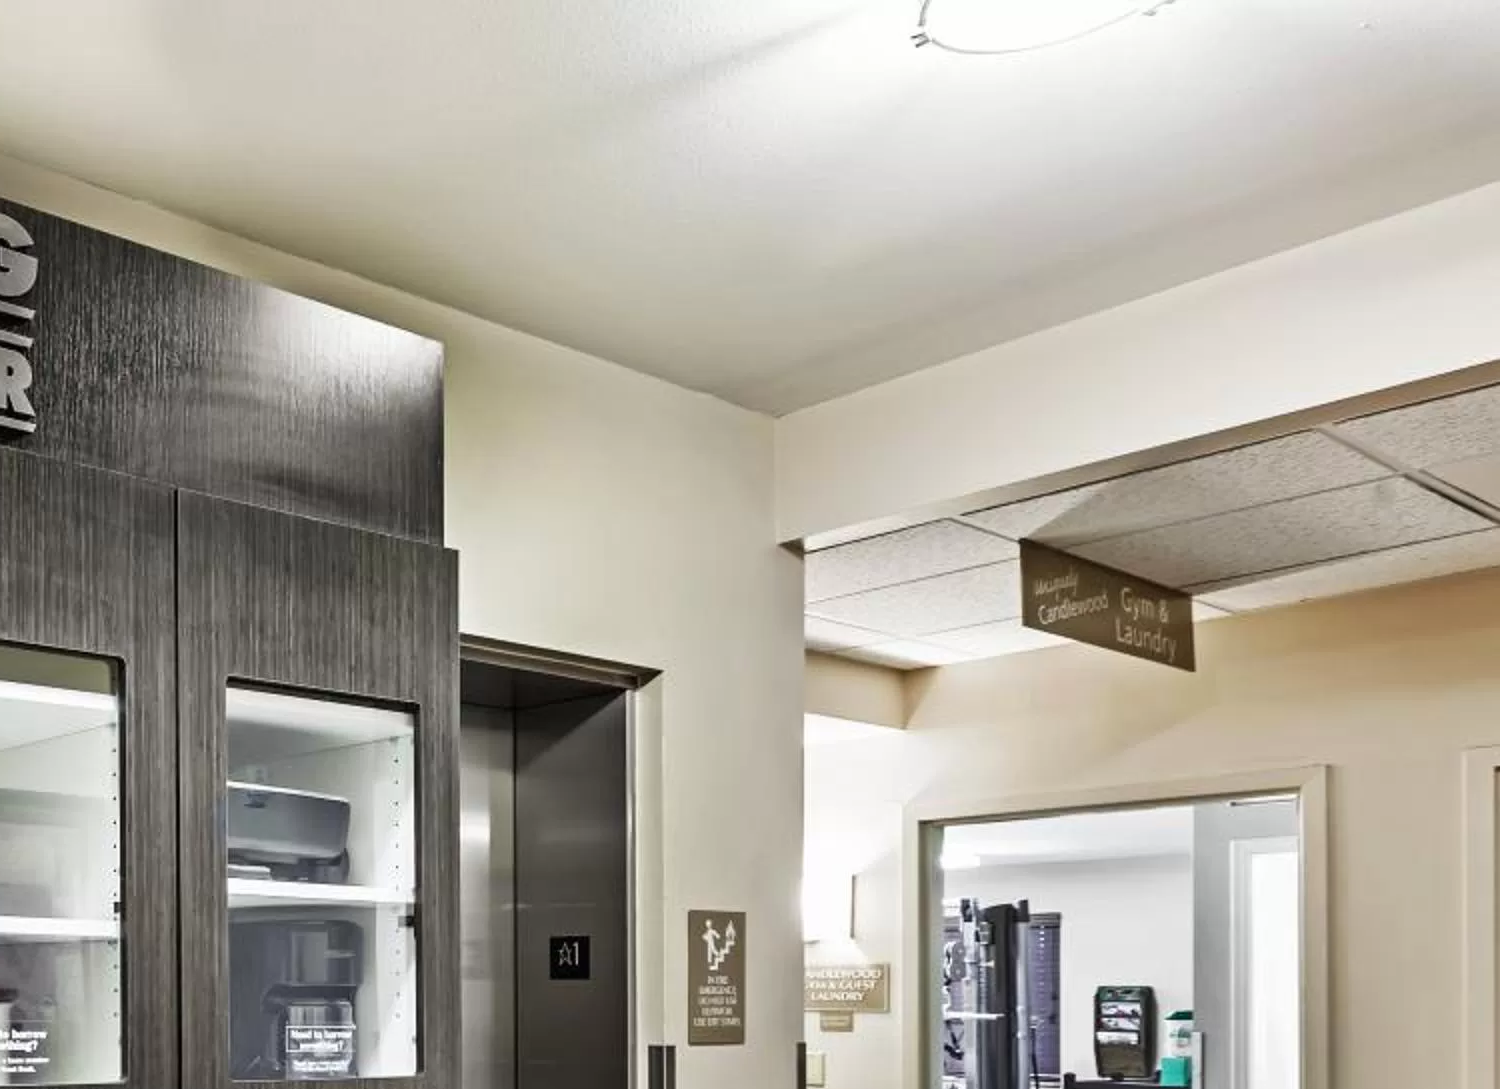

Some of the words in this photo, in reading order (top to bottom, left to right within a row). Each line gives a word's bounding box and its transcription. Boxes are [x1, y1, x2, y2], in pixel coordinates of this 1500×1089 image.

[1037, 590, 1109, 625] Candlewood
[1120, 588, 1155, 620] Gym
[1159, 600, 1170, 623] &
[1115, 616, 1177, 663] Laundry
